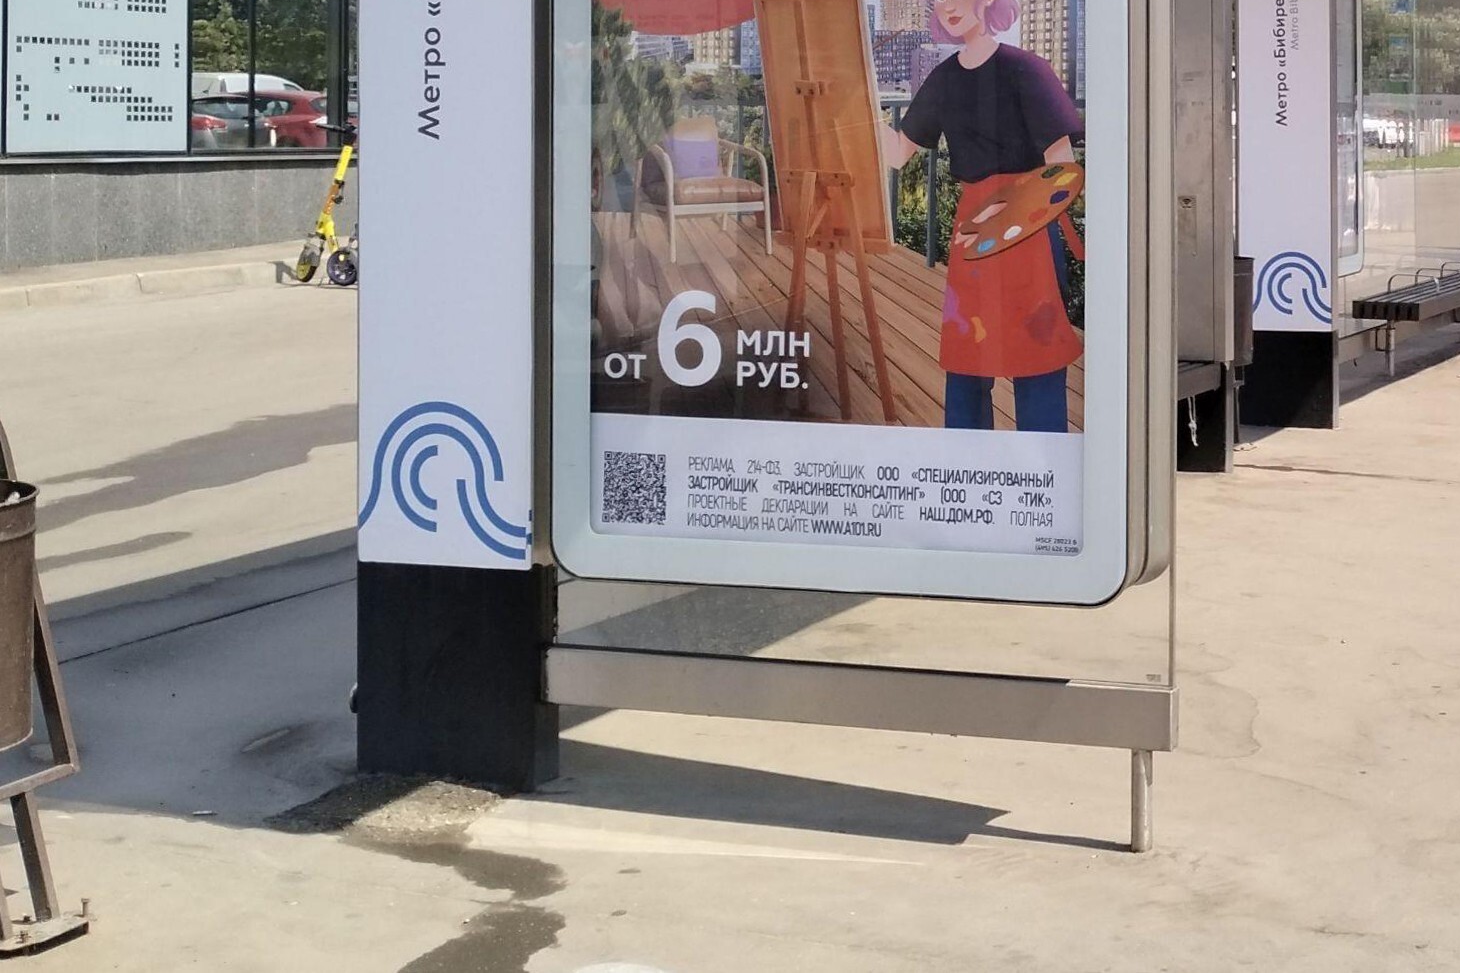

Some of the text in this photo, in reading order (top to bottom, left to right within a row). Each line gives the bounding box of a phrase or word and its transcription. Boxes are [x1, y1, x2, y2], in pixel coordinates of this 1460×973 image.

[1290, 16, 1300, 51] Metro
[417, 27, 446, 140] Метро
[1275, 71, 1290, 127] Метро
[603, 290, 722, 387] ОТ 6
[736, 329, 810, 357] МЛН
[736, 361, 809, 390] РУБ.
[687, 474, 758, 493] ЗАСТРОЙЩИК
[772, 479, 925, 502] «ТРАНСИНВЕСТКОНСАЛТИНГ»
[793, 461, 865, 480] ЗАСТРОЙЩИК
[877, 466, 900, 481] ООО
[912, 468, 1054, 488] «СПЕЦИАЛИЗИРОВАННЫЙ
[687, 494, 747, 511] ПРОЕКТНЫЕ
[761, 498, 829, 516] ДЕКЛАРАЦИИ
[844, 502, 858, 516] НА
[872, 501, 904, 520] САЙТЕ
[1010, 511, 1053, 527] ПОЛНАЯ
[687, 512, 759, 532] ИНФОРМАЦИЯ
[761, 518, 775, 531] НА
[777, 515, 809, 533] САЙТЕ
